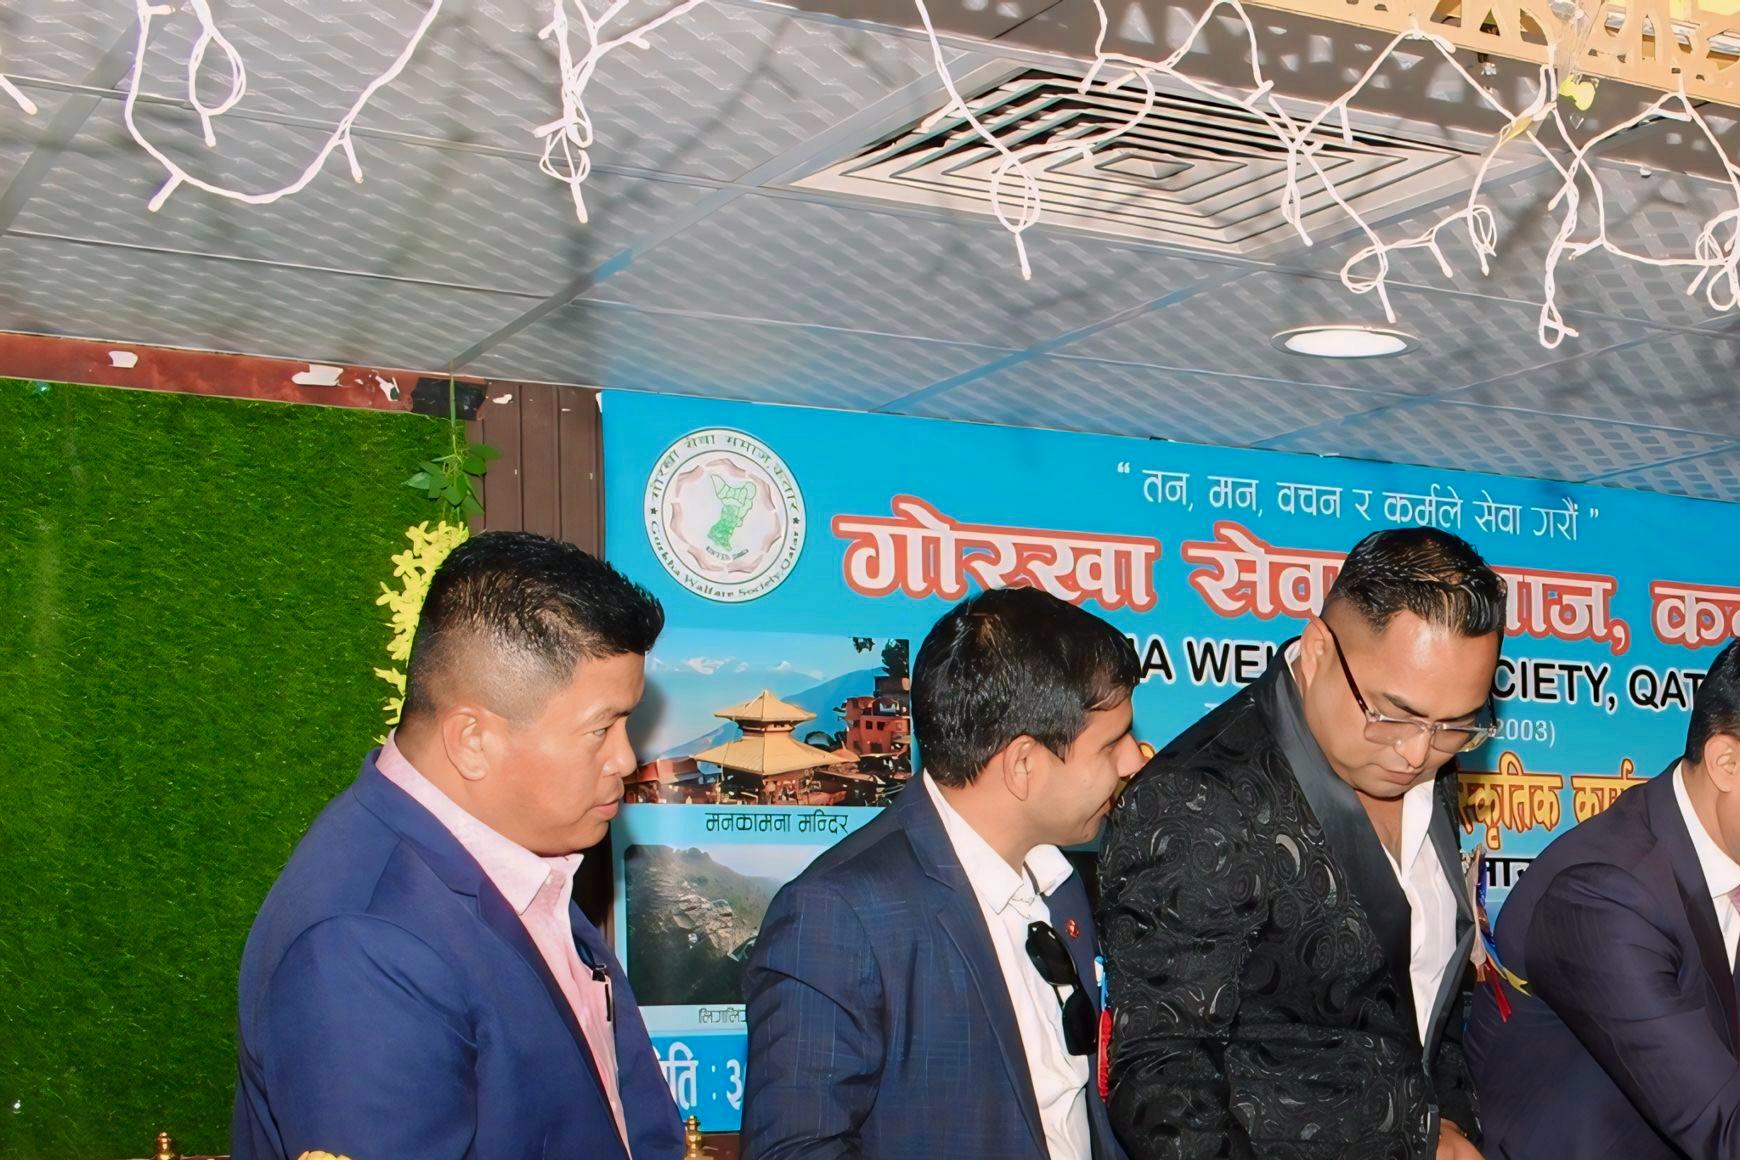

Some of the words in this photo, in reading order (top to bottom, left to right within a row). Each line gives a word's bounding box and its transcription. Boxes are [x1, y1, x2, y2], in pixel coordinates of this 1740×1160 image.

[1142, 469, 1194, 513] तन,
[1207, 475, 1264, 518] मन,
[1276, 482, 1344, 518] वचन
[1352, 488, 1373, 521] र
[1382, 483, 1464, 530] कर्मले
[1472, 489, 1523, 535] सेवा
[834, 496, 1160, 612] गोरखा
[705, 812, 792, 834] मनकामना
[797, 808, 849, 834] मन्दिर
